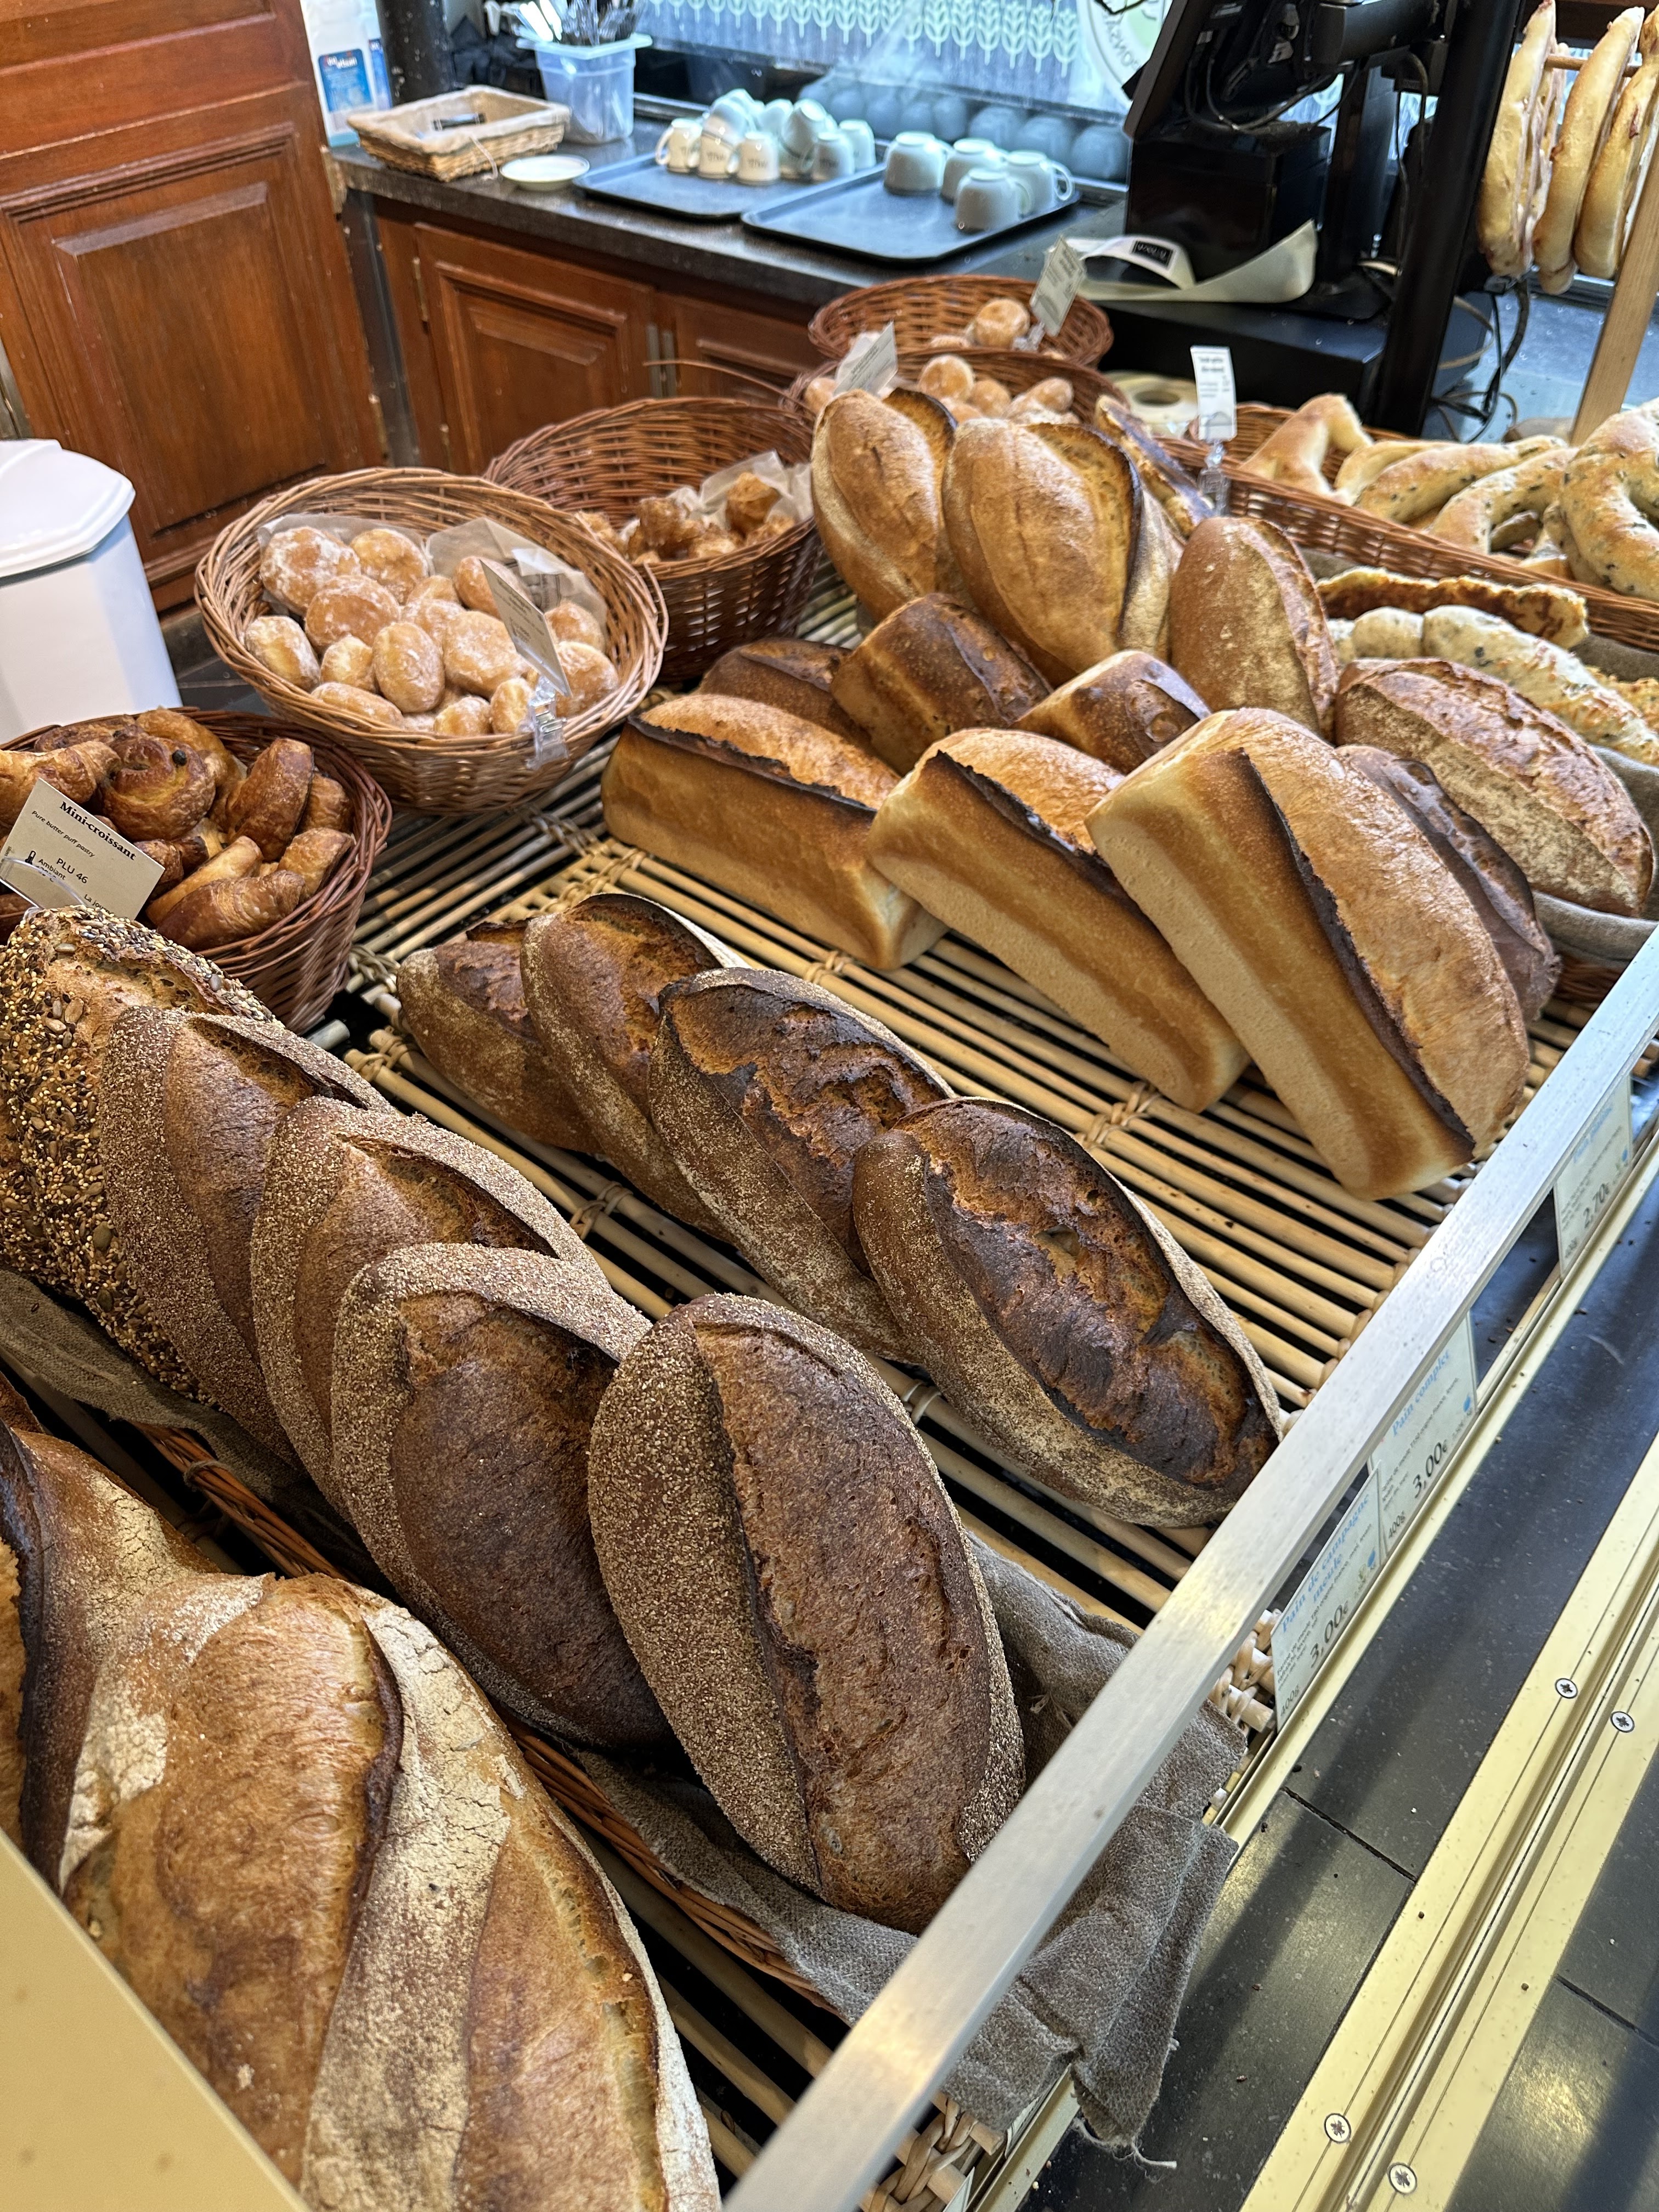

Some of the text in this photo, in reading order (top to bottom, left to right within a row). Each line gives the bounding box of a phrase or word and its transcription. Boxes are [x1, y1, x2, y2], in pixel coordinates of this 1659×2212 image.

[32, 810, 95, 857] Pure butter puff pastry
[59, 801, 137, 861] Mini-croissant
[38, 859, 66, 881] Ambiant
[56, 857, 75, 874] PLU
[76, 873, 88, 884] 46
[84, 894, 92, 902] La
[1392, 1403, 1414, 1437] Pain
[1415, 1349, 1450, 1403] complet
[1413, 1439, 1447, 1499] 3,00€
[1282, 1593, 1306, 1633] Pain
[1308, 1571, 1320, 1593] de
[1322, 1493, 1369, 1570] campagne
[1313, 1553, 1342, 1602] meule
[1310, 1600, 1349, 1668] 3,00€
[1280, 1683, 1299, 1717] 400g
